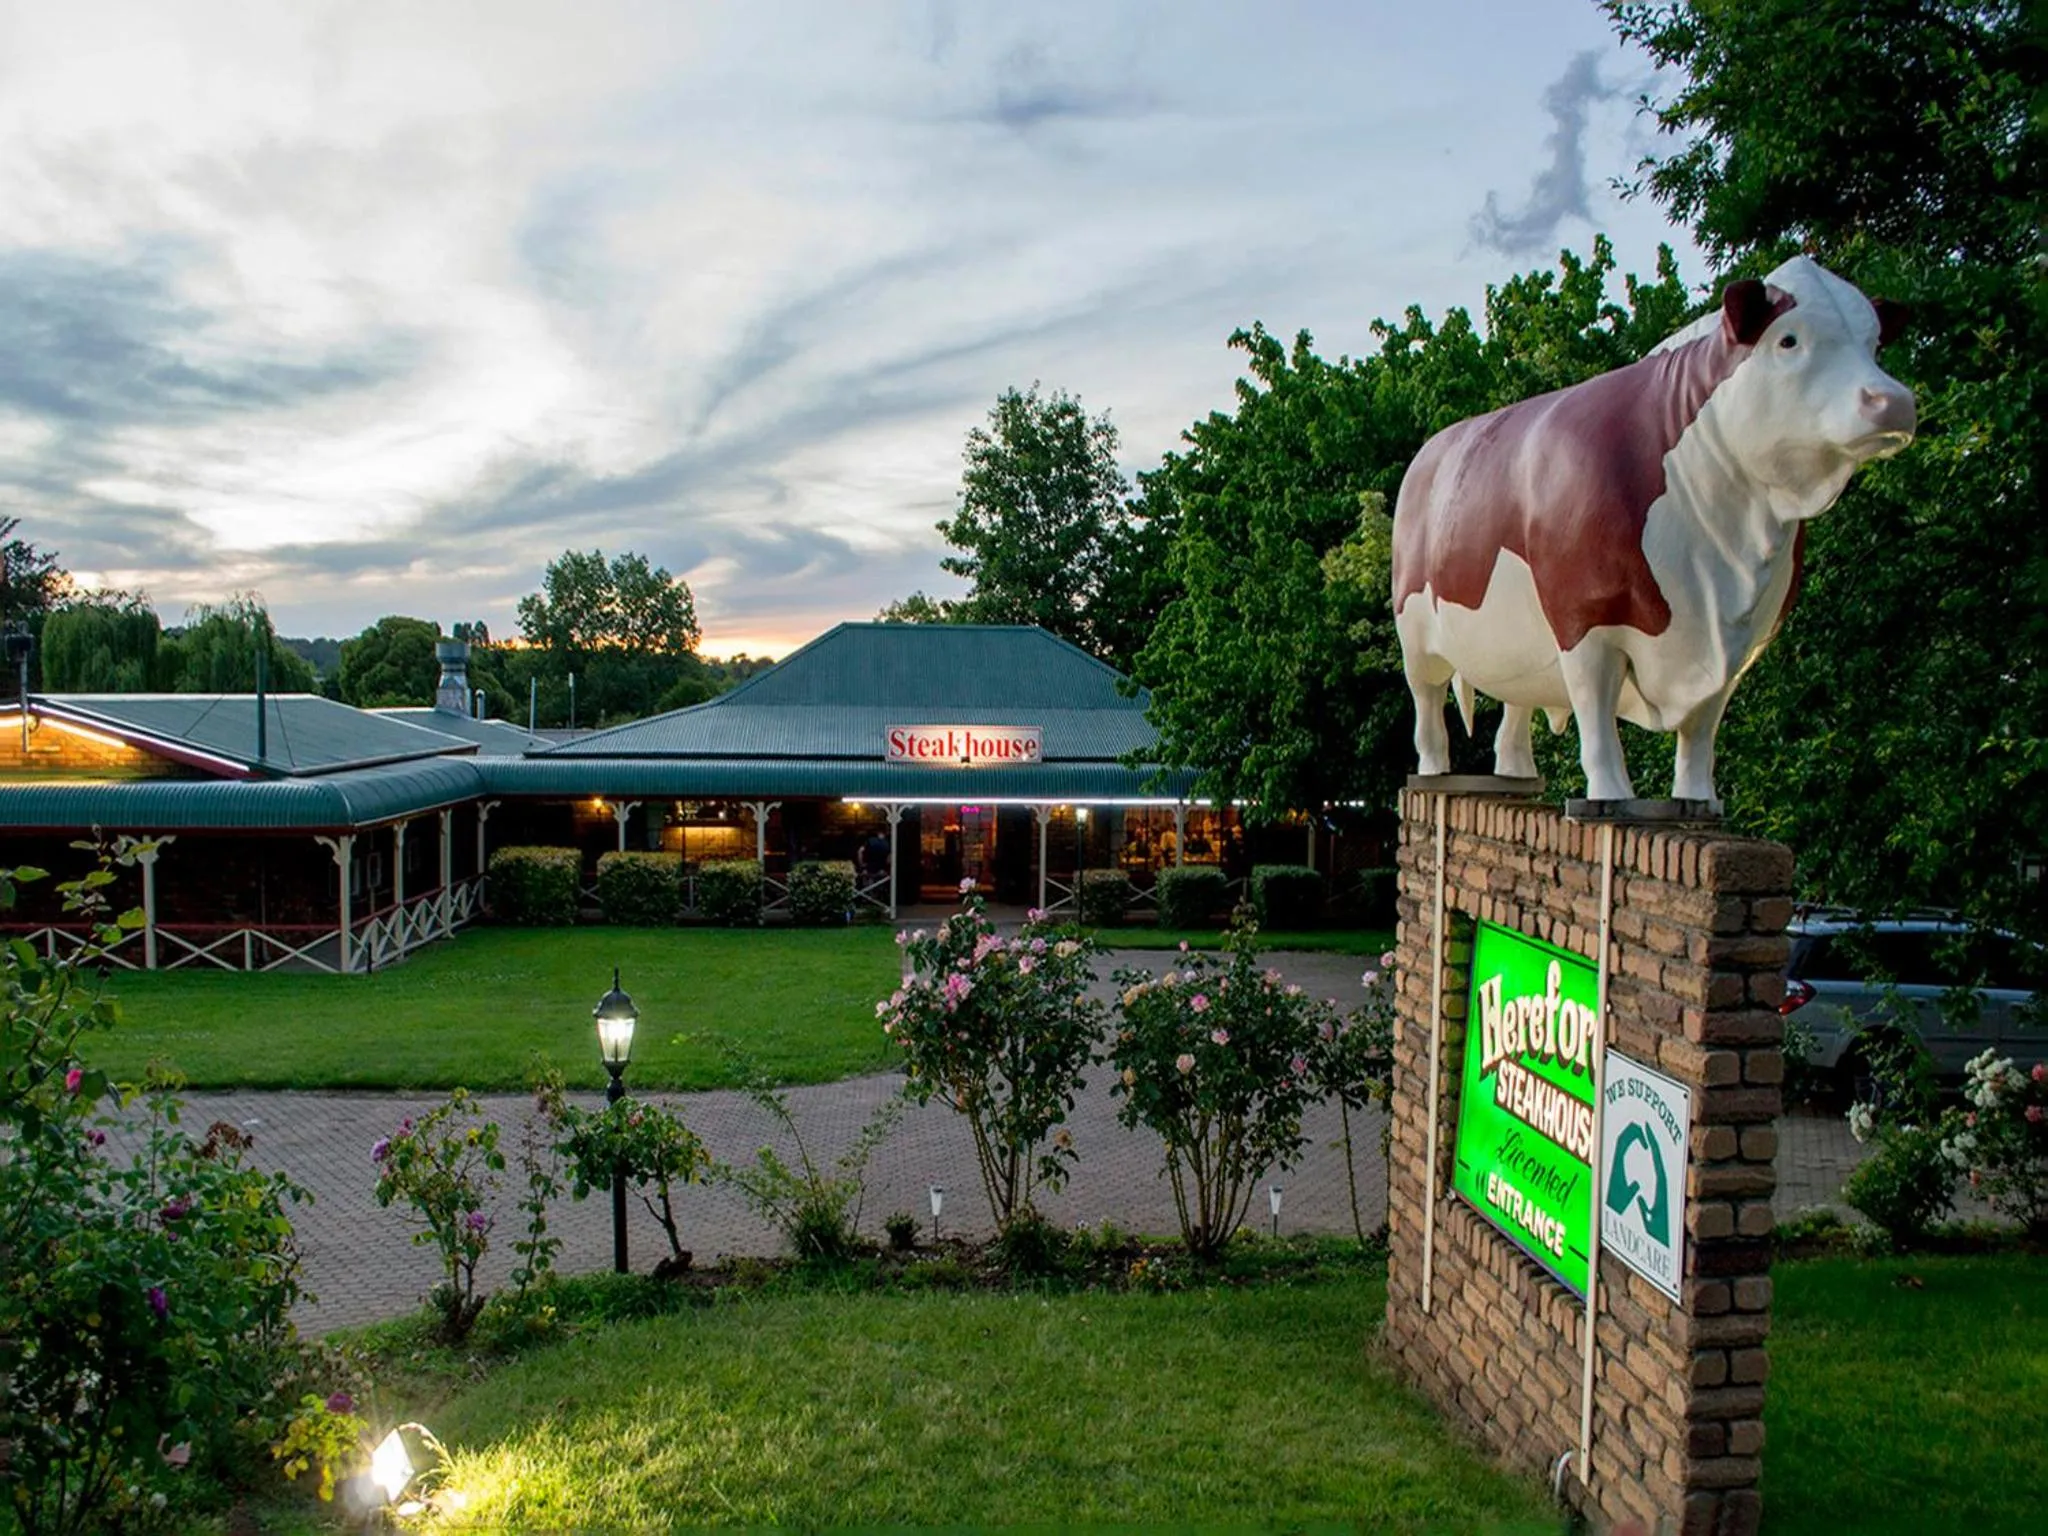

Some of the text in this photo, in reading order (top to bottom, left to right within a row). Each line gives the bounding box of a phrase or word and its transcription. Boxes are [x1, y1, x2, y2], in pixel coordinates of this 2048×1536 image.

[1497, 1059, 1594, 1164] STEAKHOUS
[1606, 1078, 1682, 1146] WE SUPPORT
[1486, 1172, 1567, 1258] ENTRANCE
[1605, 1210, 1672, 1281] LANDCARE
